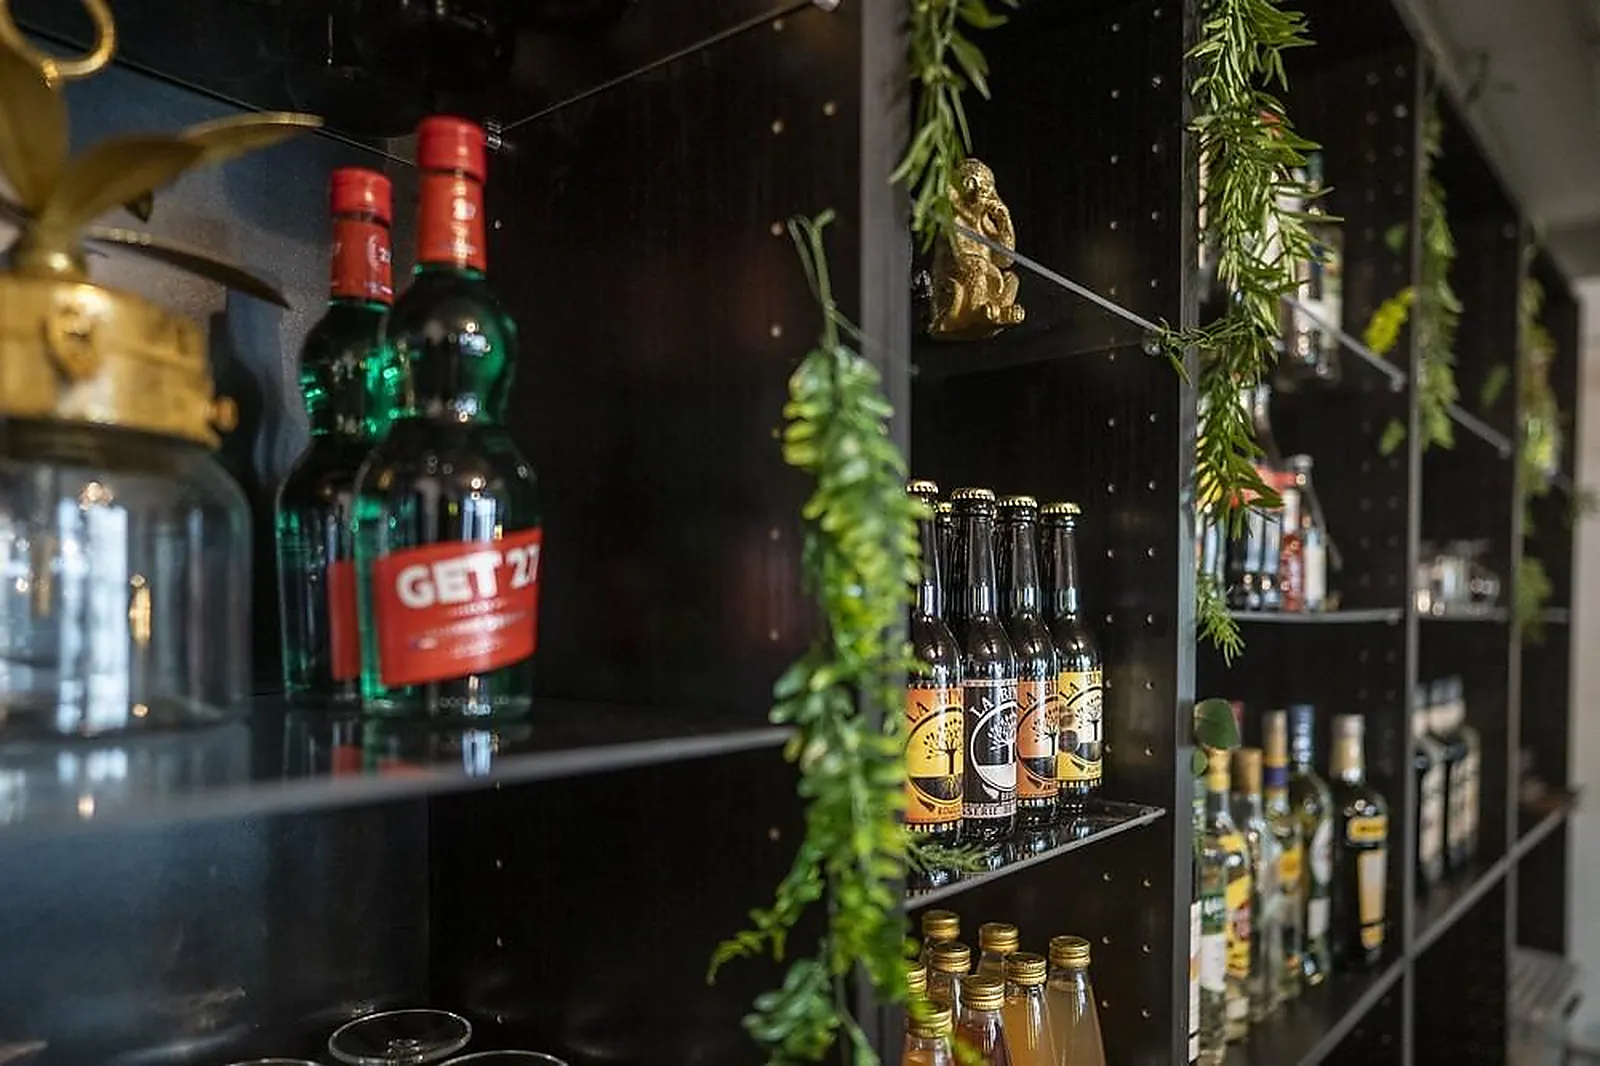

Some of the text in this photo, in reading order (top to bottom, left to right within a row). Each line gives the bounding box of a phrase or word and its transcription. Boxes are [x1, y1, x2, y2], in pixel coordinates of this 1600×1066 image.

[396, 544, 541, 609] GET 27
[1017, 691, 1037, 711] LA
[1059, 682, 1080, 700] LA
[905, 702, 930, 723] LA
[970, 696, 996, 718] LA
